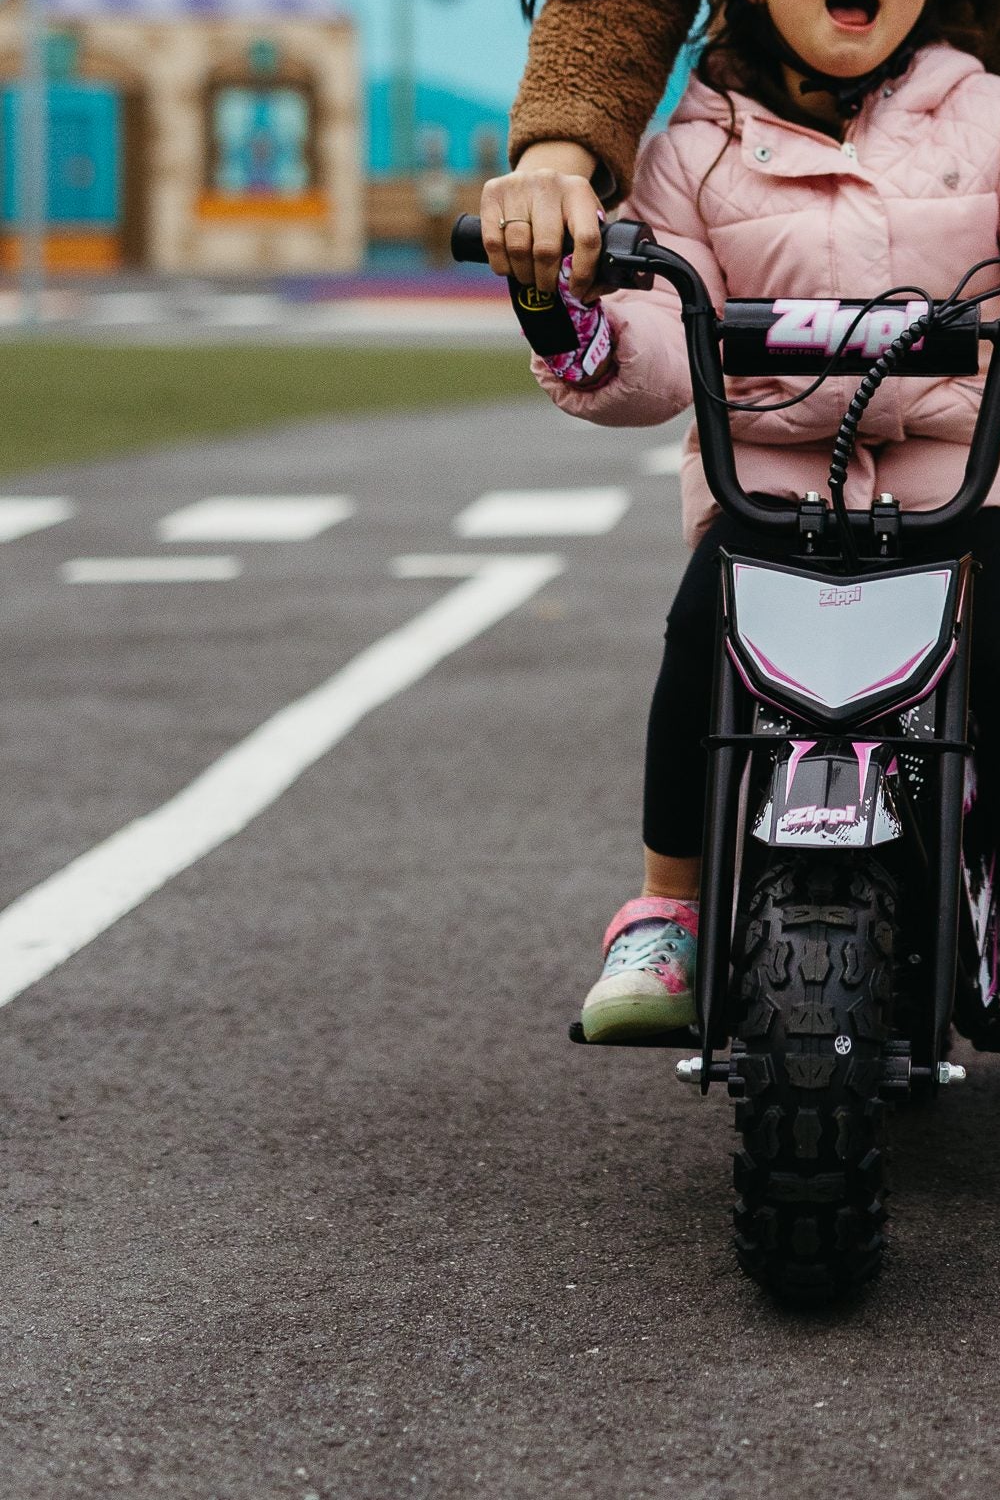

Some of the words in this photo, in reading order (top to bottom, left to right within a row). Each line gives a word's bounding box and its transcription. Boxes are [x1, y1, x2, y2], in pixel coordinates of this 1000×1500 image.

[765, 299, 930, 358] Zippi
[819, 586, 861, 607] Zippi
[786, 805, 857, 826] Zippi
